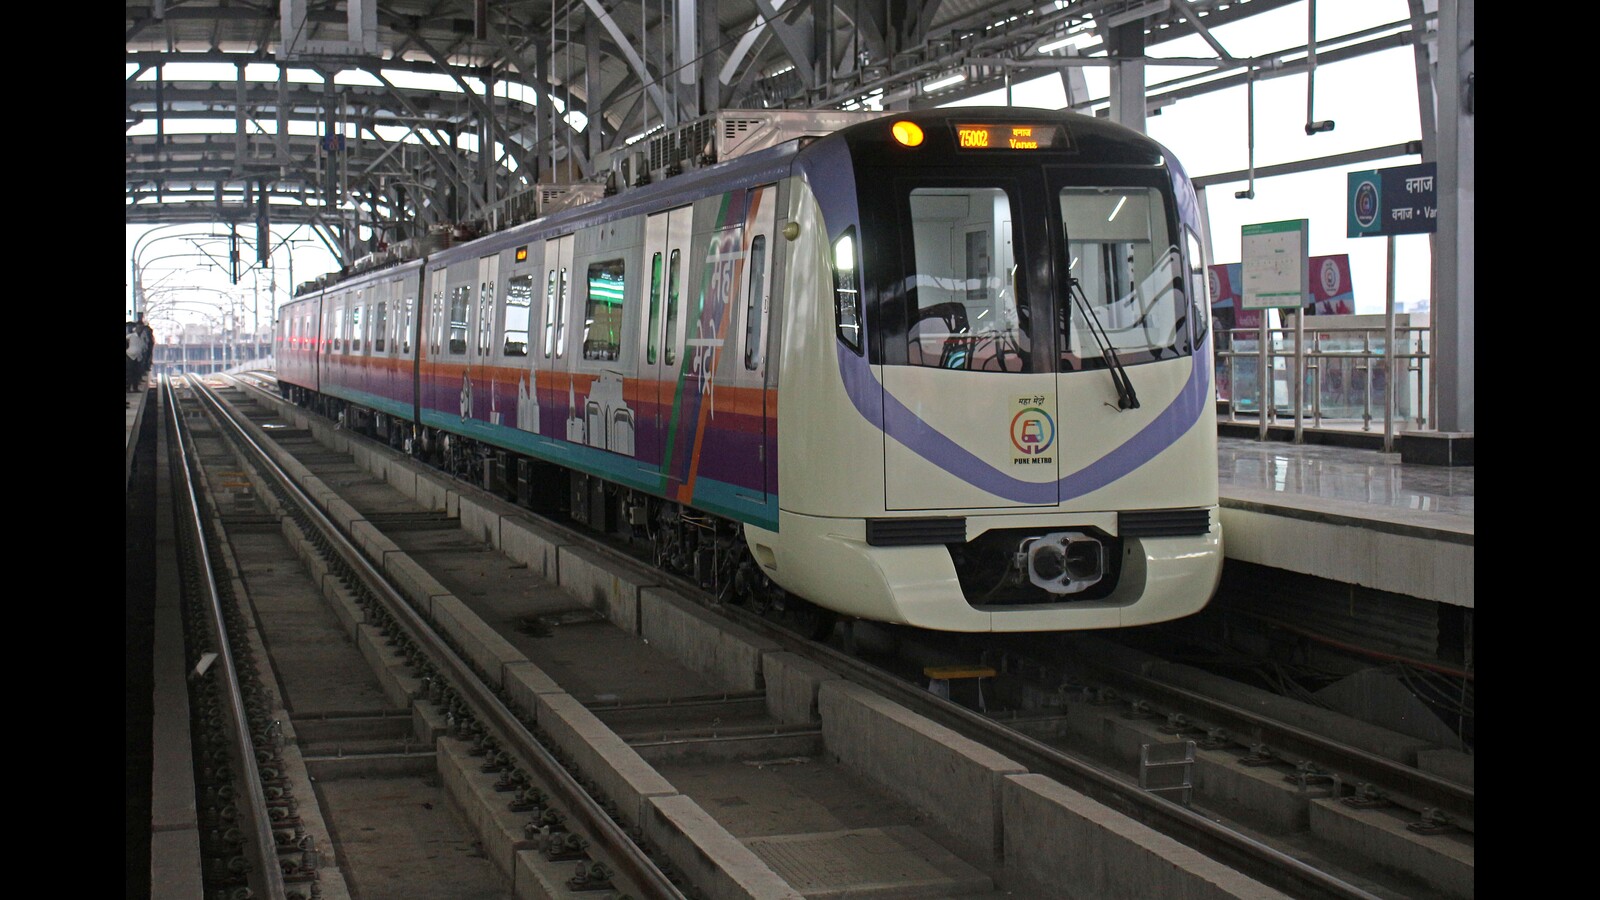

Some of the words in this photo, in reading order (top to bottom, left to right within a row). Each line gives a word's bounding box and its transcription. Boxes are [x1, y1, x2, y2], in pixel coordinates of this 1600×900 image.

[960, 130, 988, 147] 75002
[1009, 138, 1038, 149] Vanaz
[1405, 176, 1433, 193] वनाज
[1391, 207, 1413, 220] वनाज
[1018, 398, 1031, 406] महा
